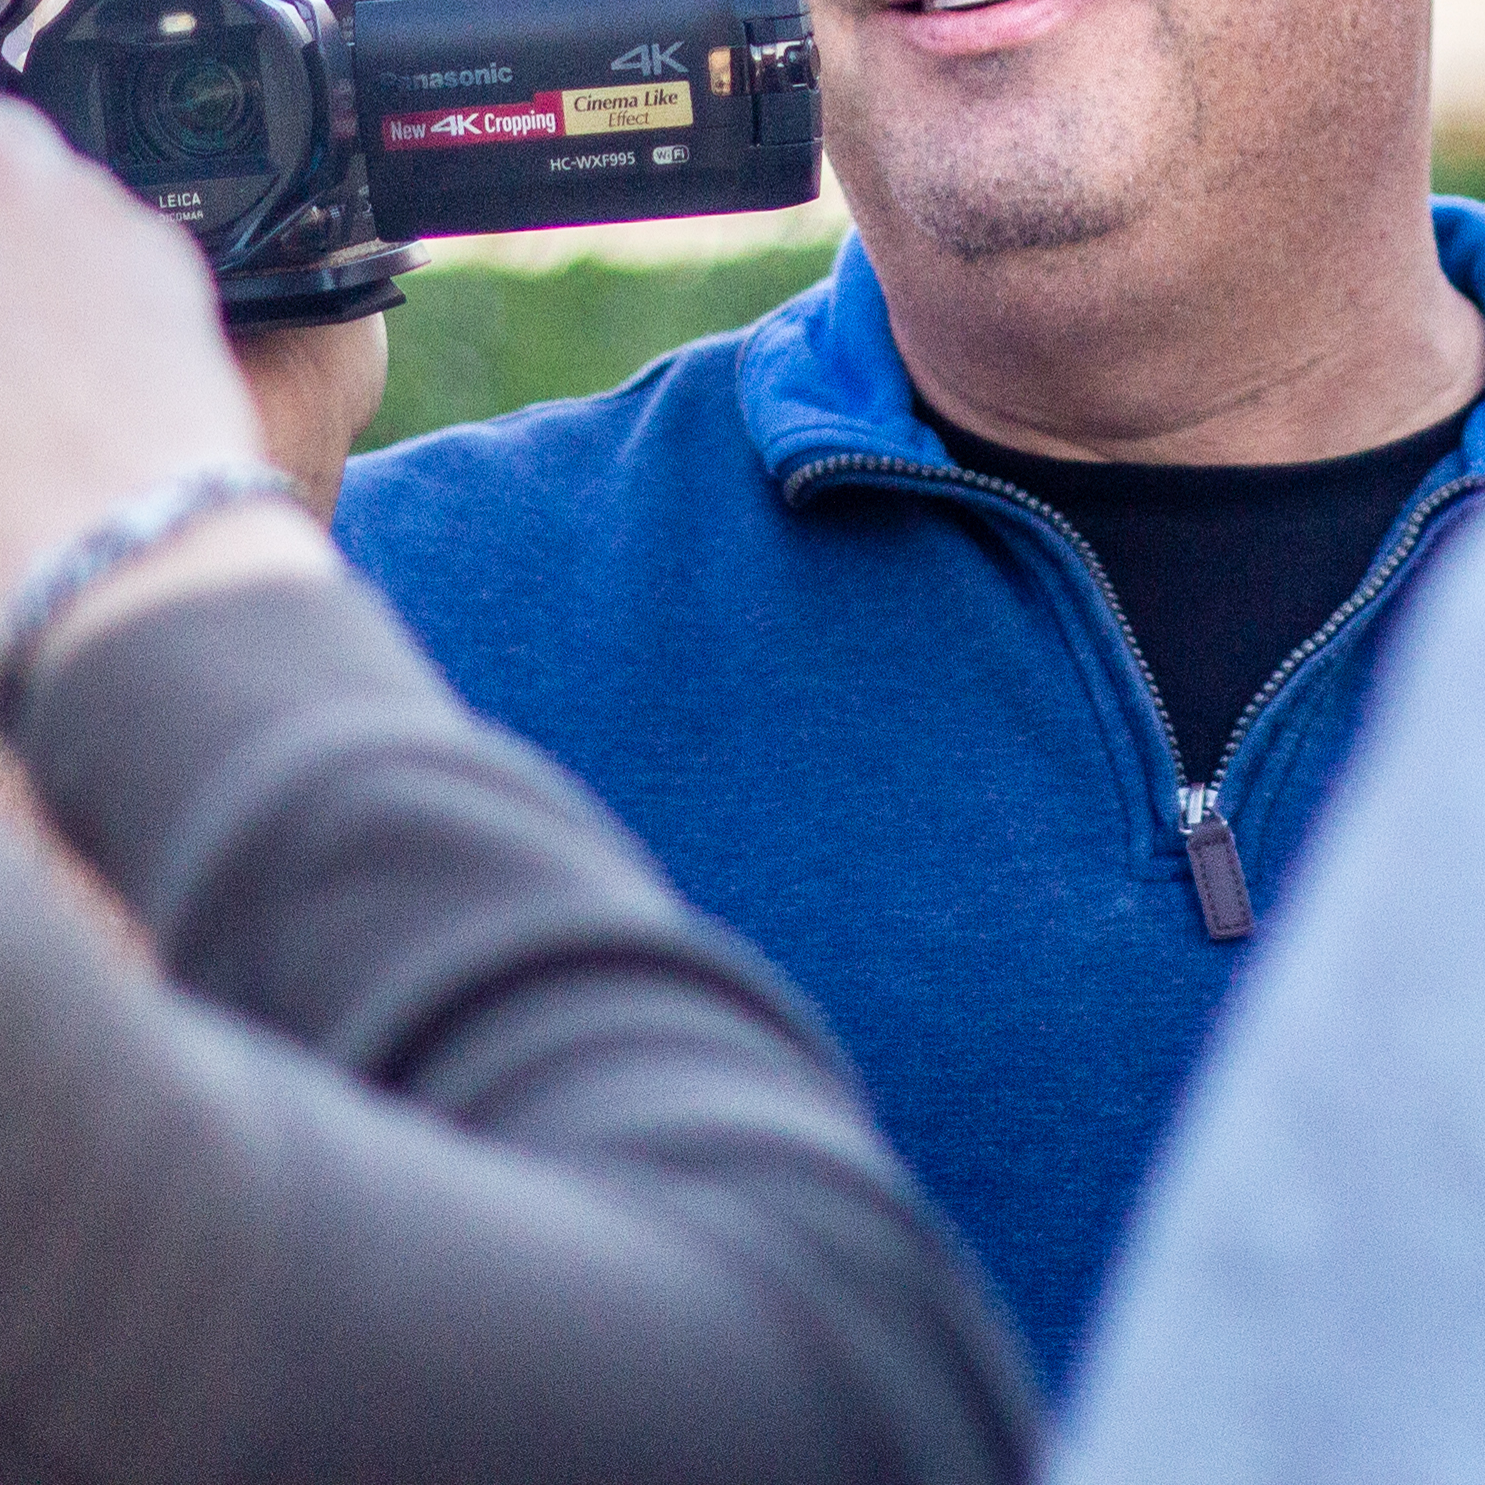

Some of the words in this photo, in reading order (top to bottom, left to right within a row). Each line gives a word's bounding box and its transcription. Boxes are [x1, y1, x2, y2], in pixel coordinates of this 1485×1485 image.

[611, 41, 689, 76] 4K
[573, 93, 638, 114] Cinema
[643, 89, 679, 109] Like
[390, 118, 426, 142] New
[429, 113, 483, 137] 4K
[483, 109, 556, 135] Cropping
[607, 111, 650, 128] Effect
[549, 151, 636, 172] HC-WXF995
[159, 192, 201, 207] LEICA
